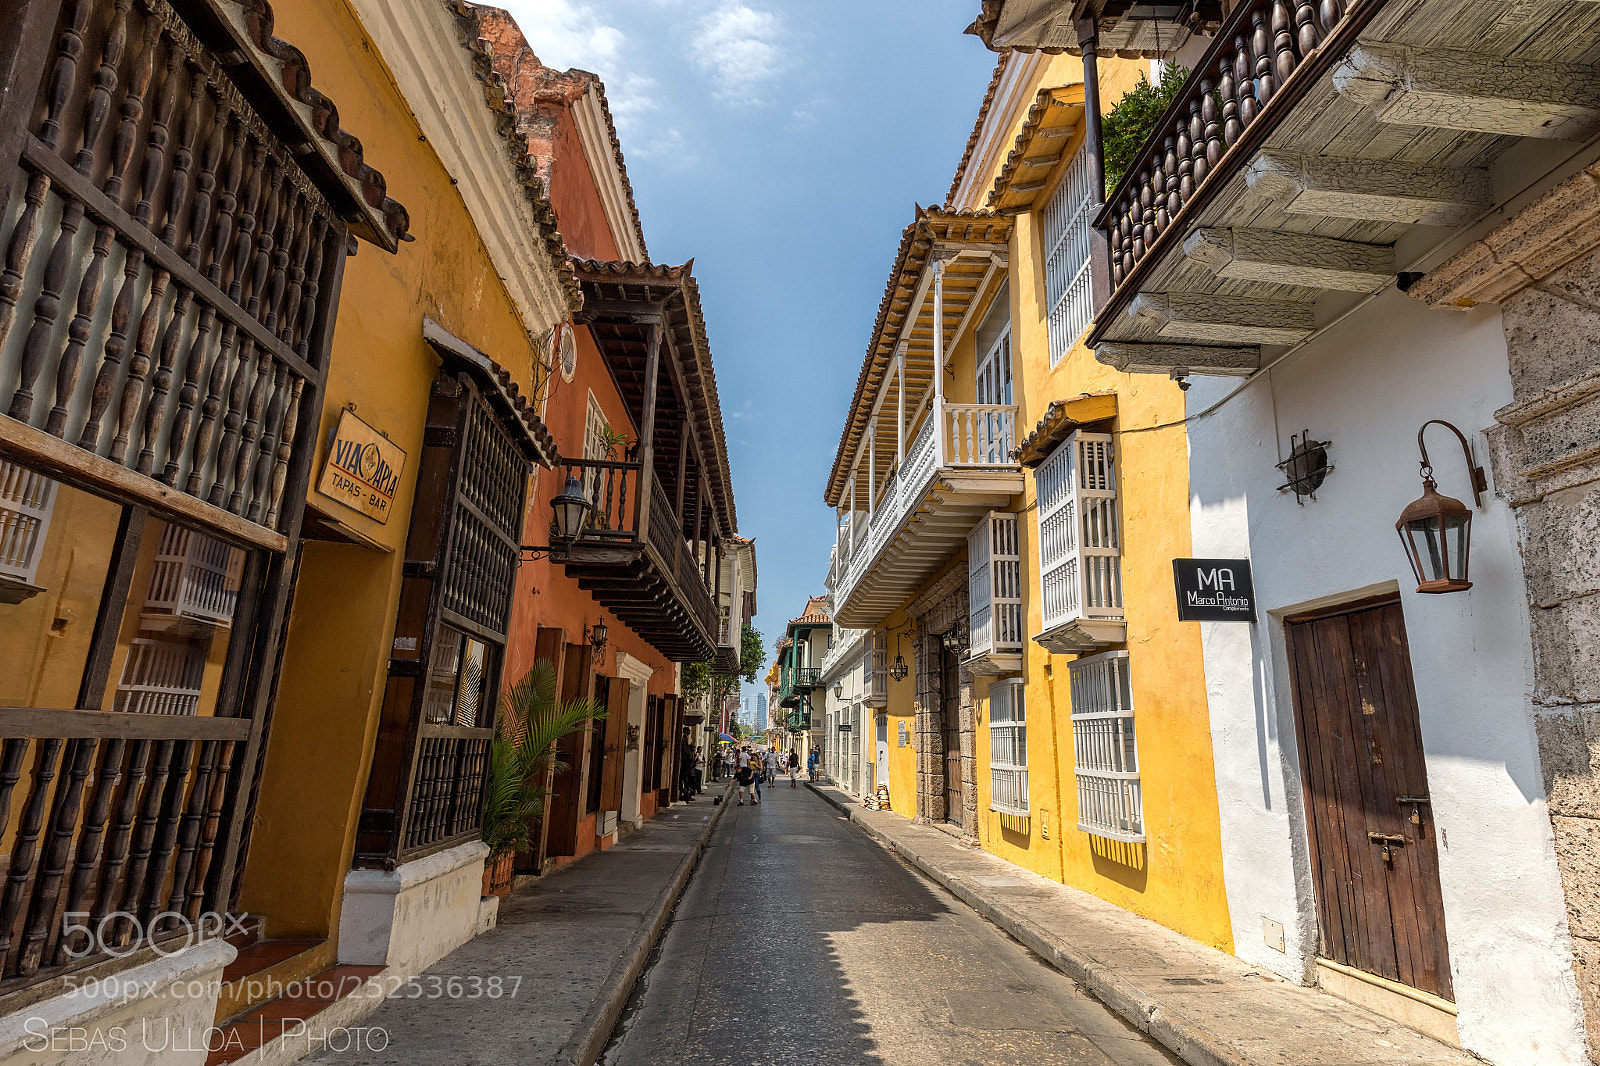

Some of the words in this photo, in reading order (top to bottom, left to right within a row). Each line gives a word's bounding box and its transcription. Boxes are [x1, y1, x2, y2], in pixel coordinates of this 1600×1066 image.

[336, 439, 362, 476] VIA
[372, 459, 398, 497] APIA
[331, 472, 361, 497] TAPAS
[368, 494, 387, 512] BAR
[1196, 567, 1236, 591] MA
[1187, 590, 1216, 605] Marco
[1216, 591, 1249, 606] Antonio
